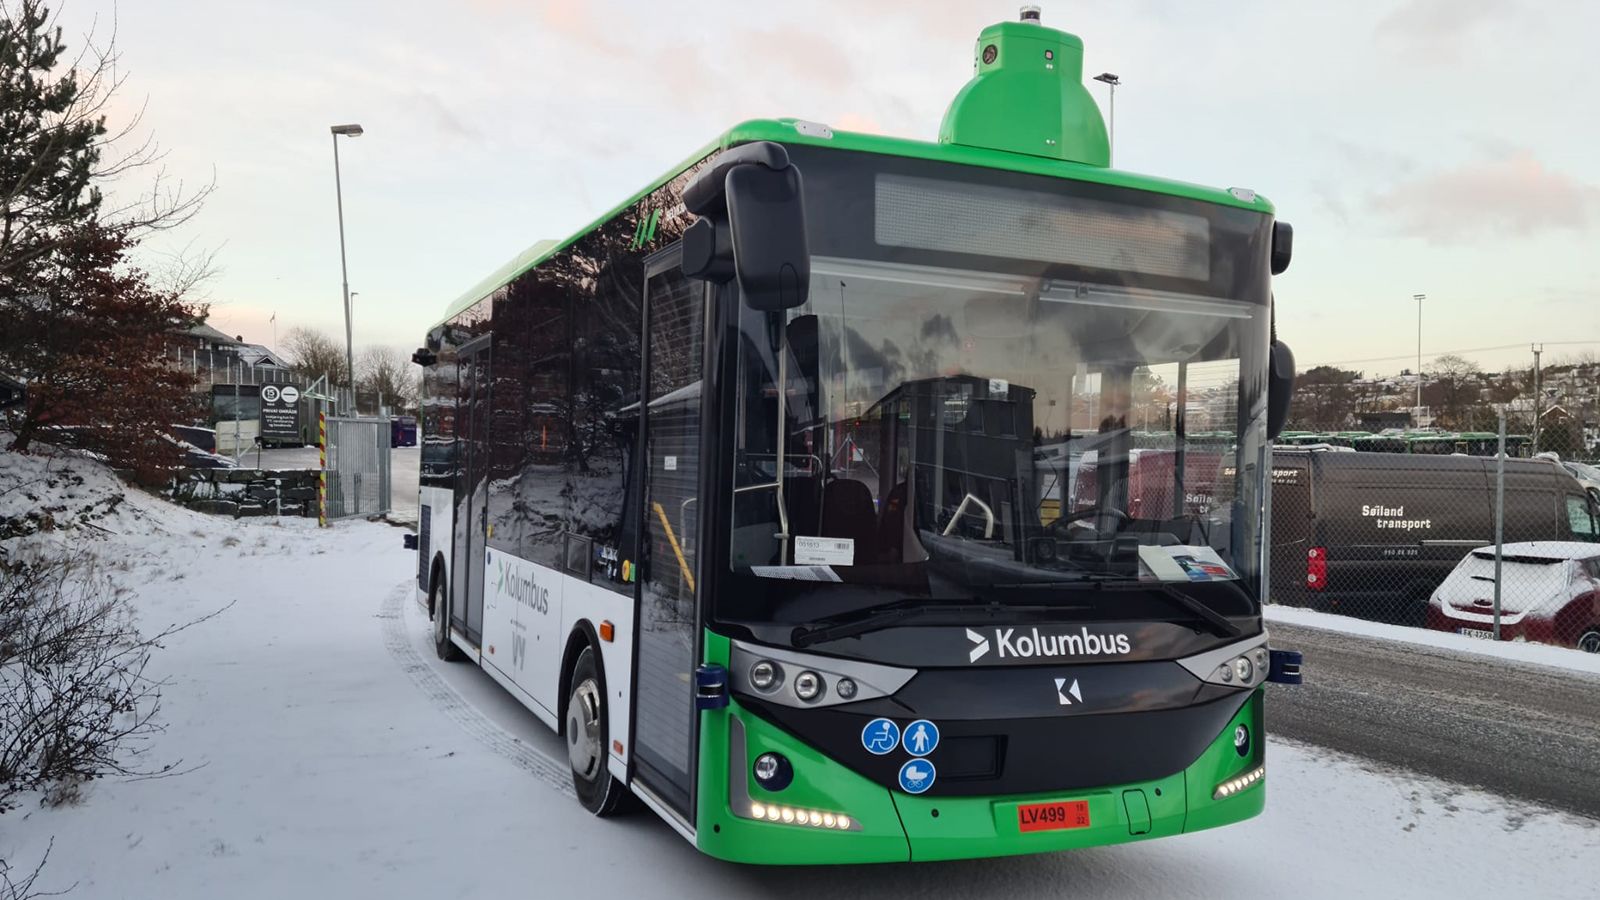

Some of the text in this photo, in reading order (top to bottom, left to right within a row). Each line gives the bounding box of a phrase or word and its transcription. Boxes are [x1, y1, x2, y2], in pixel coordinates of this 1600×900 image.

[1376, 519, 1431, 531] transport
[505, 561, 549, 615] Kolumbus
[995, 626, 1131, 657] Kolumbus
[1020, 806, 1066, 824] LV499
